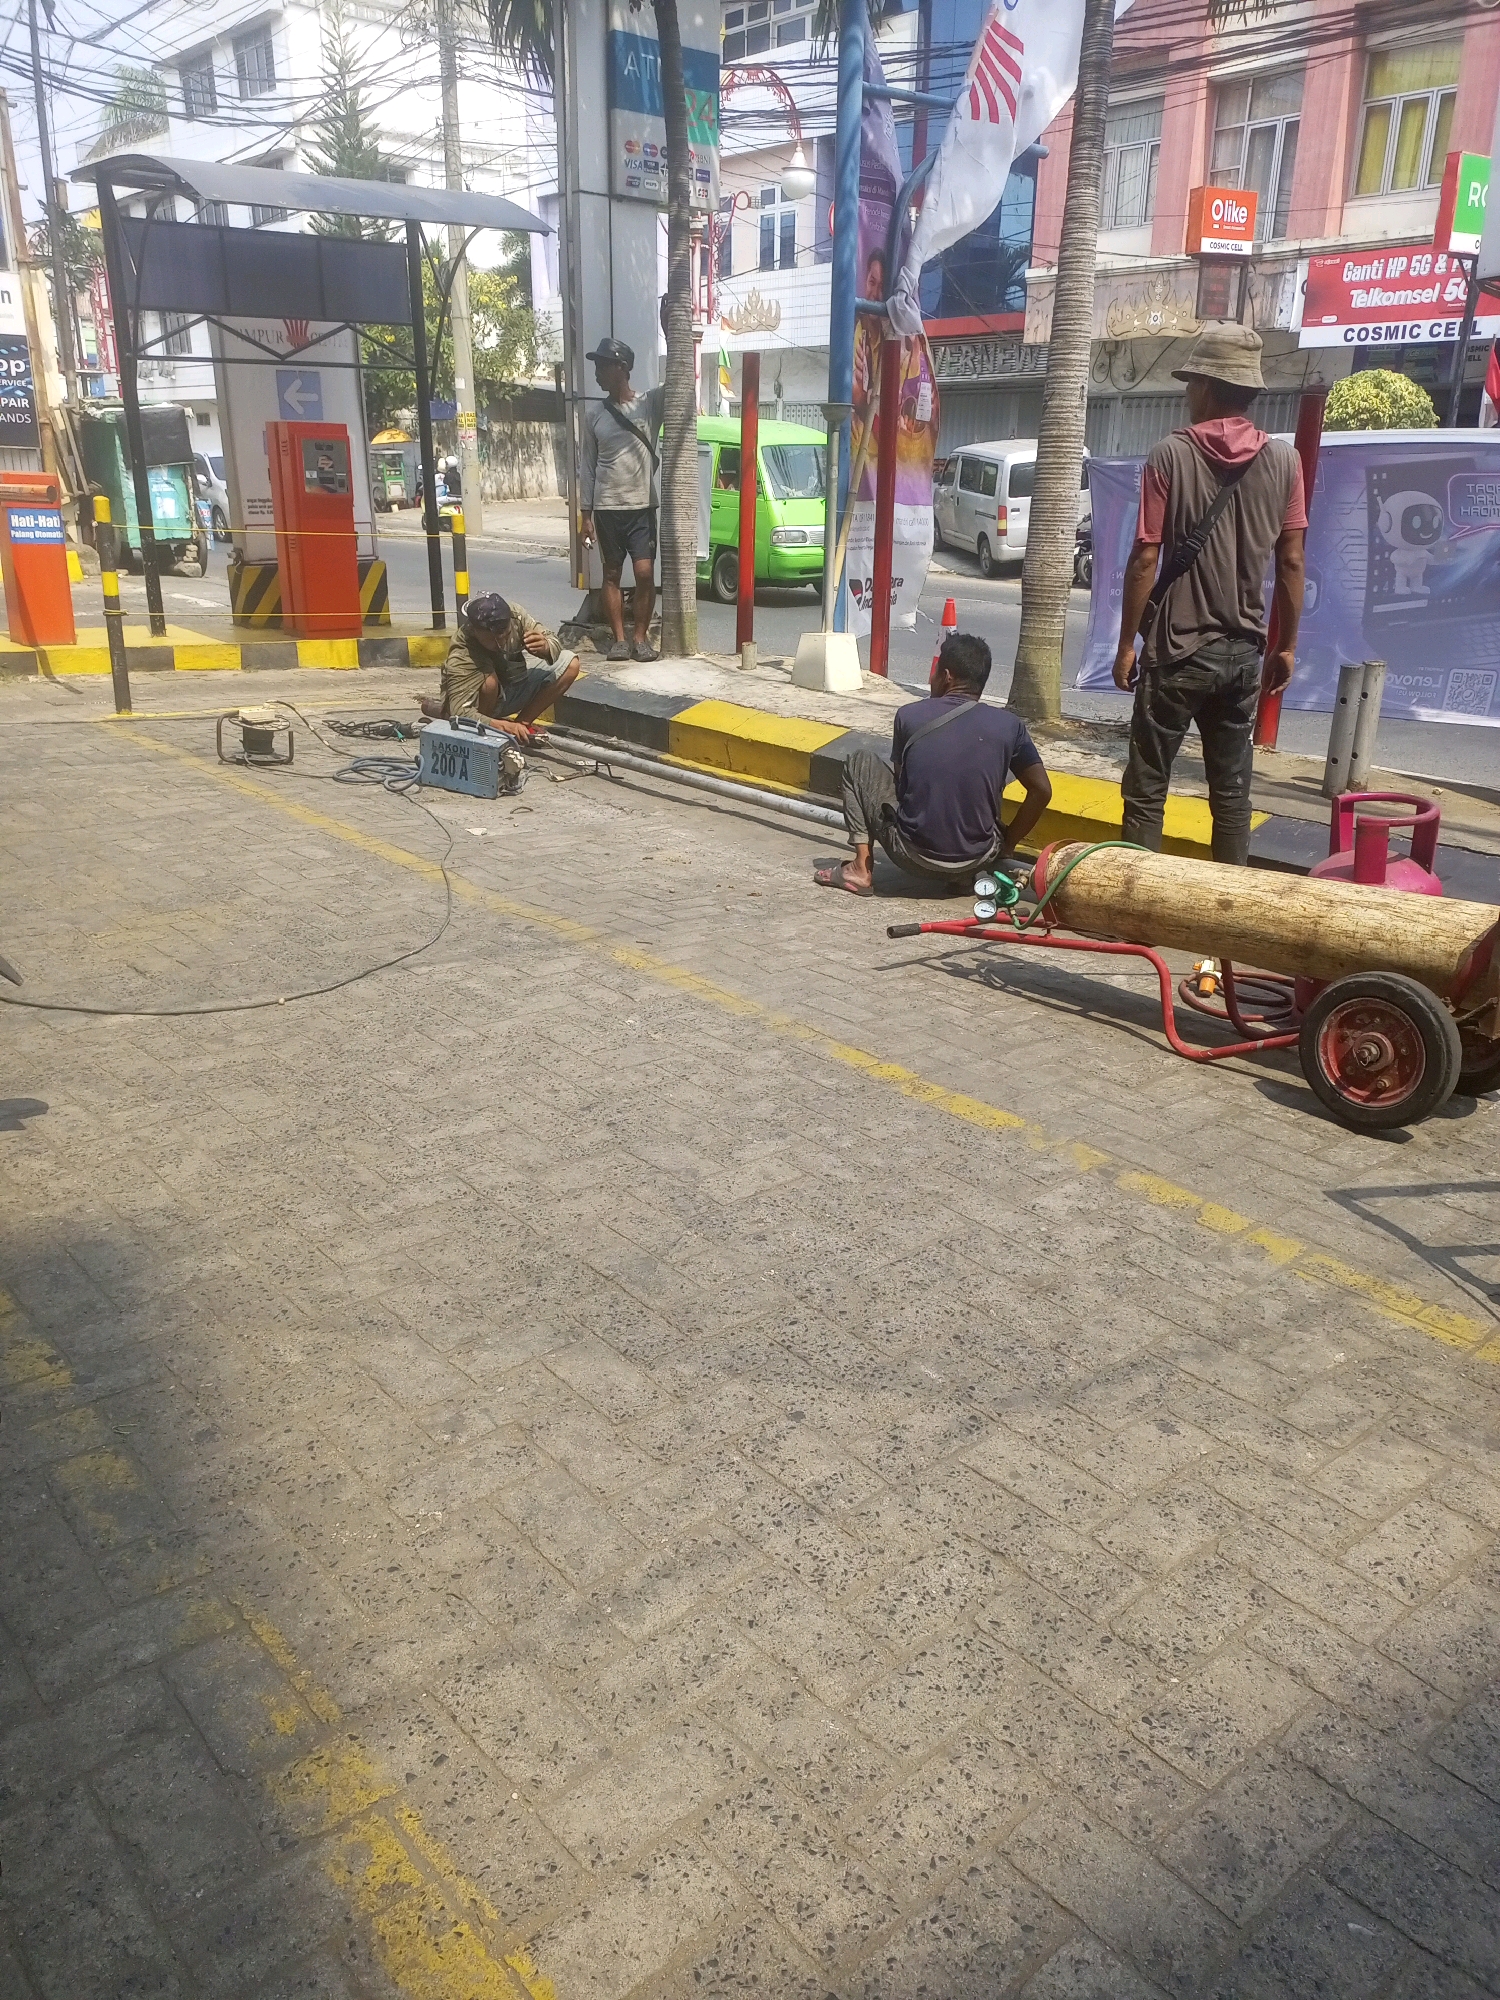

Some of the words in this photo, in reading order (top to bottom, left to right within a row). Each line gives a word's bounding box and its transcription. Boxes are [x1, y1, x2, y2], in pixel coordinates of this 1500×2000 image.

[624, 158, 643, 171] VISA
[1211, 198, 1248, 224] Olike
[1210, 241, 1230, 251] COSMIC
[1231, 243, 1243, 252] CELL
[1342, 258, 1385, 283] Ganti
[1385, 256, 1407, 280] HP
[1409, 253, 1432, 277] 5G
[1434, 254, 1449, 275] &
[1350, 282, 1441, 309] Telkomsel
[1344, 323, 1426, 343] COSMIC
[1429, 321, 1482, 338] CEL
[10, 514, 61, 528] Hati-Hati
[11, 530, 34, 539] Palang
[432, 740, 470, 757] LAKONI
